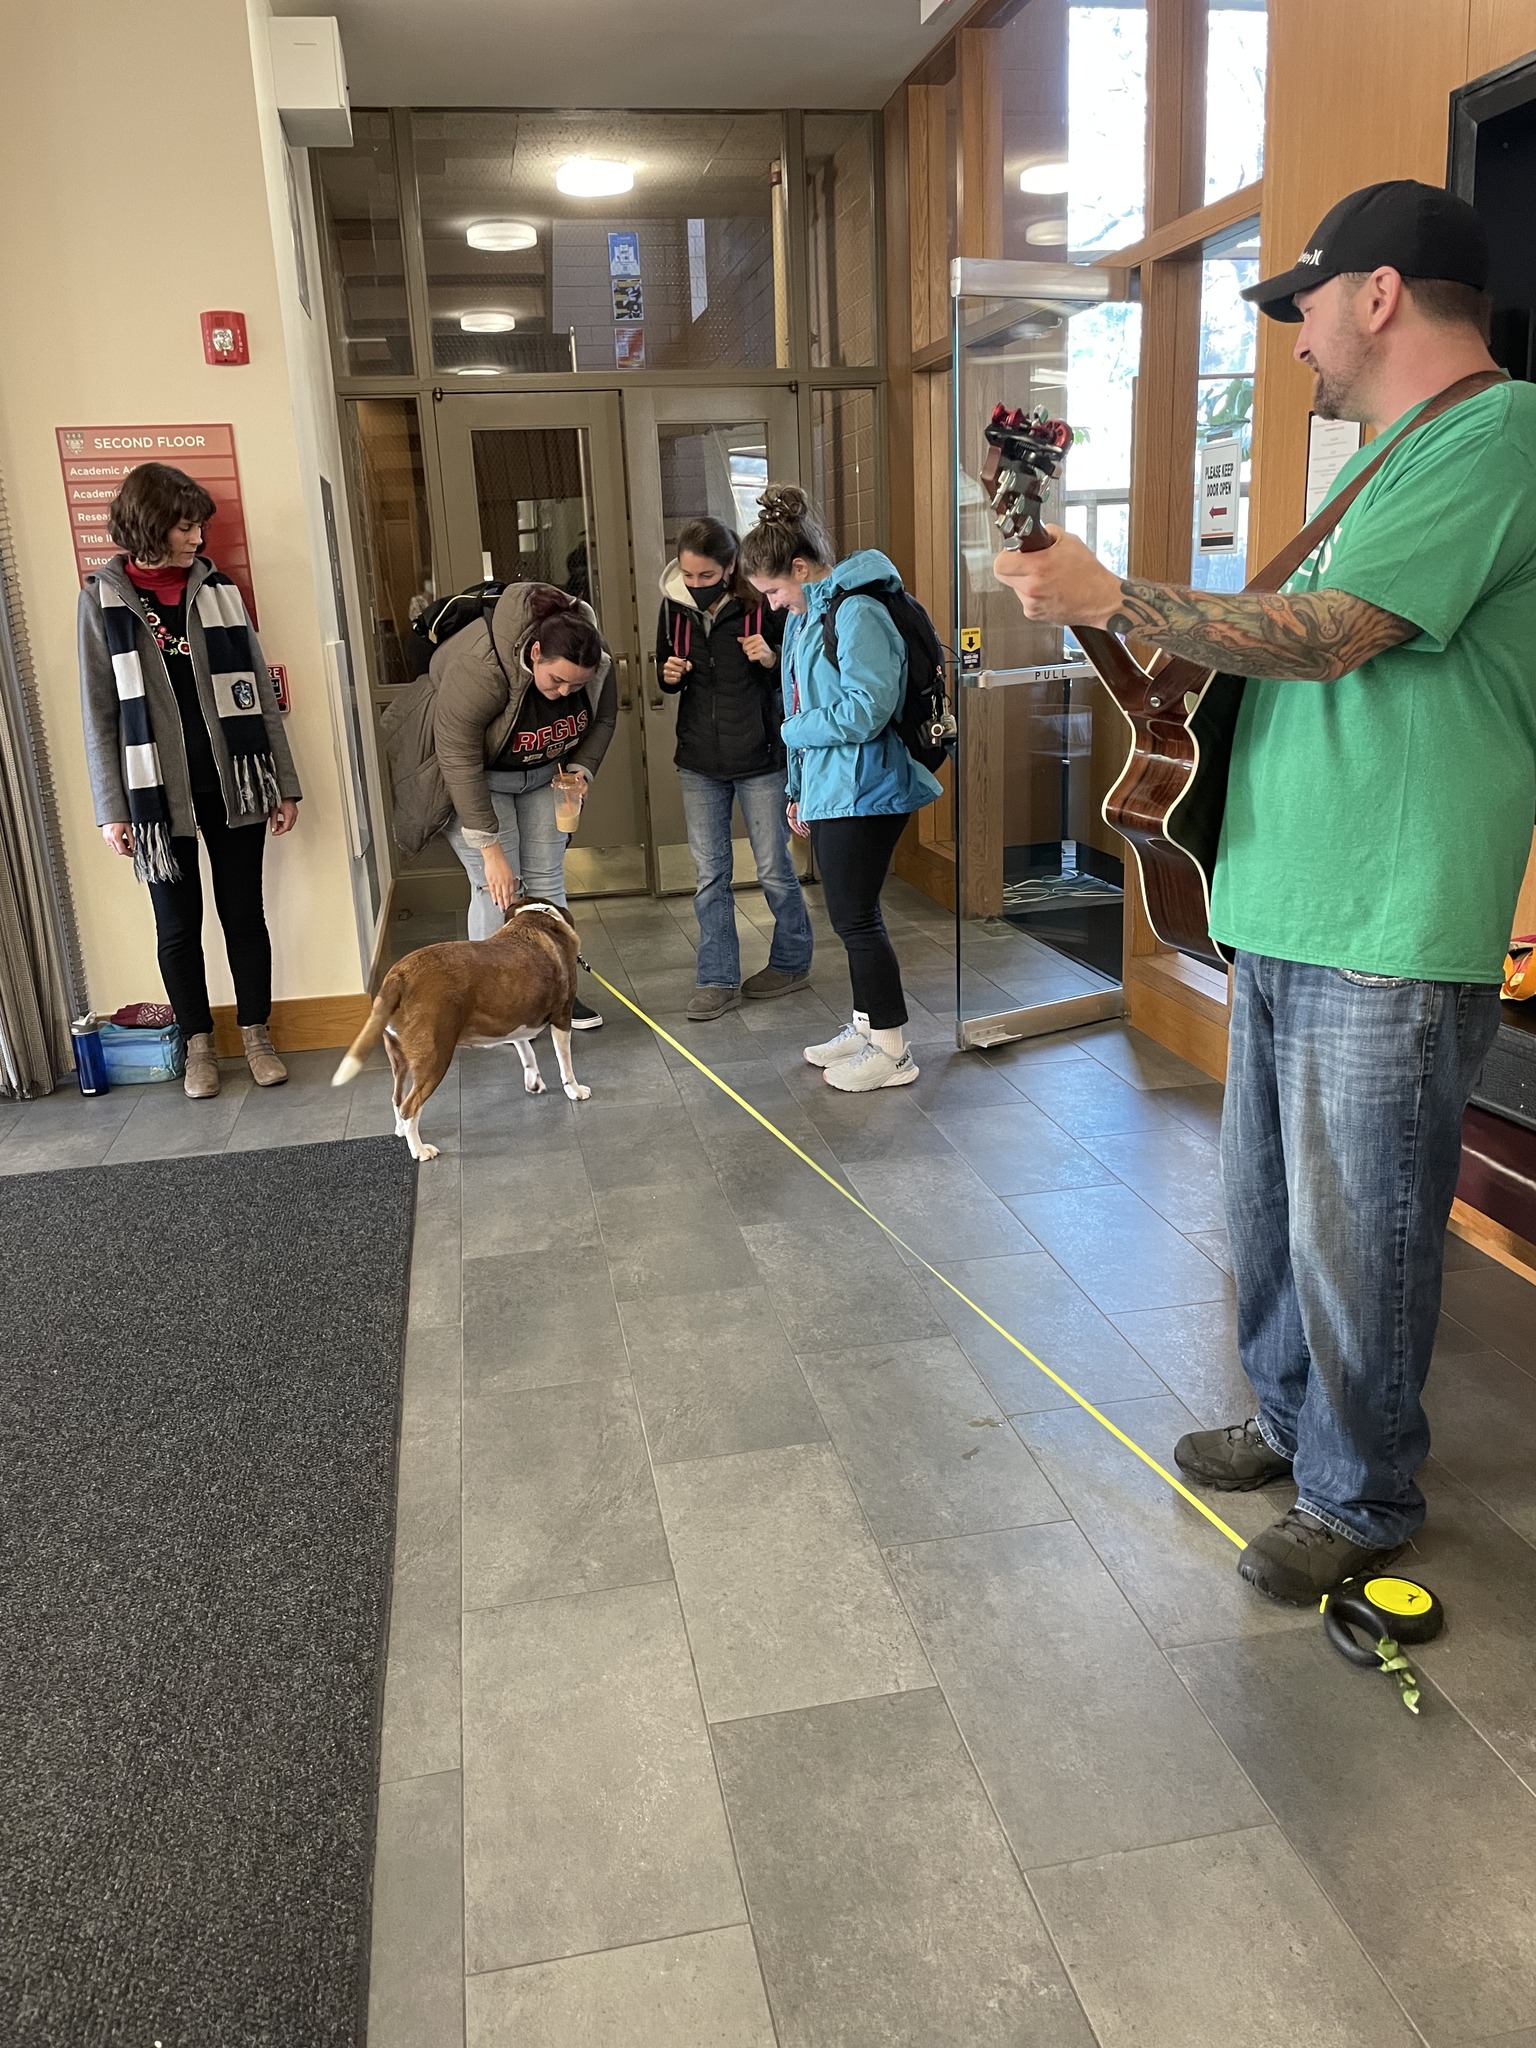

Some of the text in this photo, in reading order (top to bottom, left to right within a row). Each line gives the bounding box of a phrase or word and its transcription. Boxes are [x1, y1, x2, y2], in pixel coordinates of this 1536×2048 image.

[94, 435, 206, 449] SECOND FLOOR
[70, 466, 120, 476] Academic
[1204, 462, 1233, 480] PLEASE KEEP
[1206, 481, 1232, 497] DOOR OPEN
[81, 534, 104, 544] Title
[267, 667, 281, 678] RE
[1034, 668, 1067, 681] PULL
